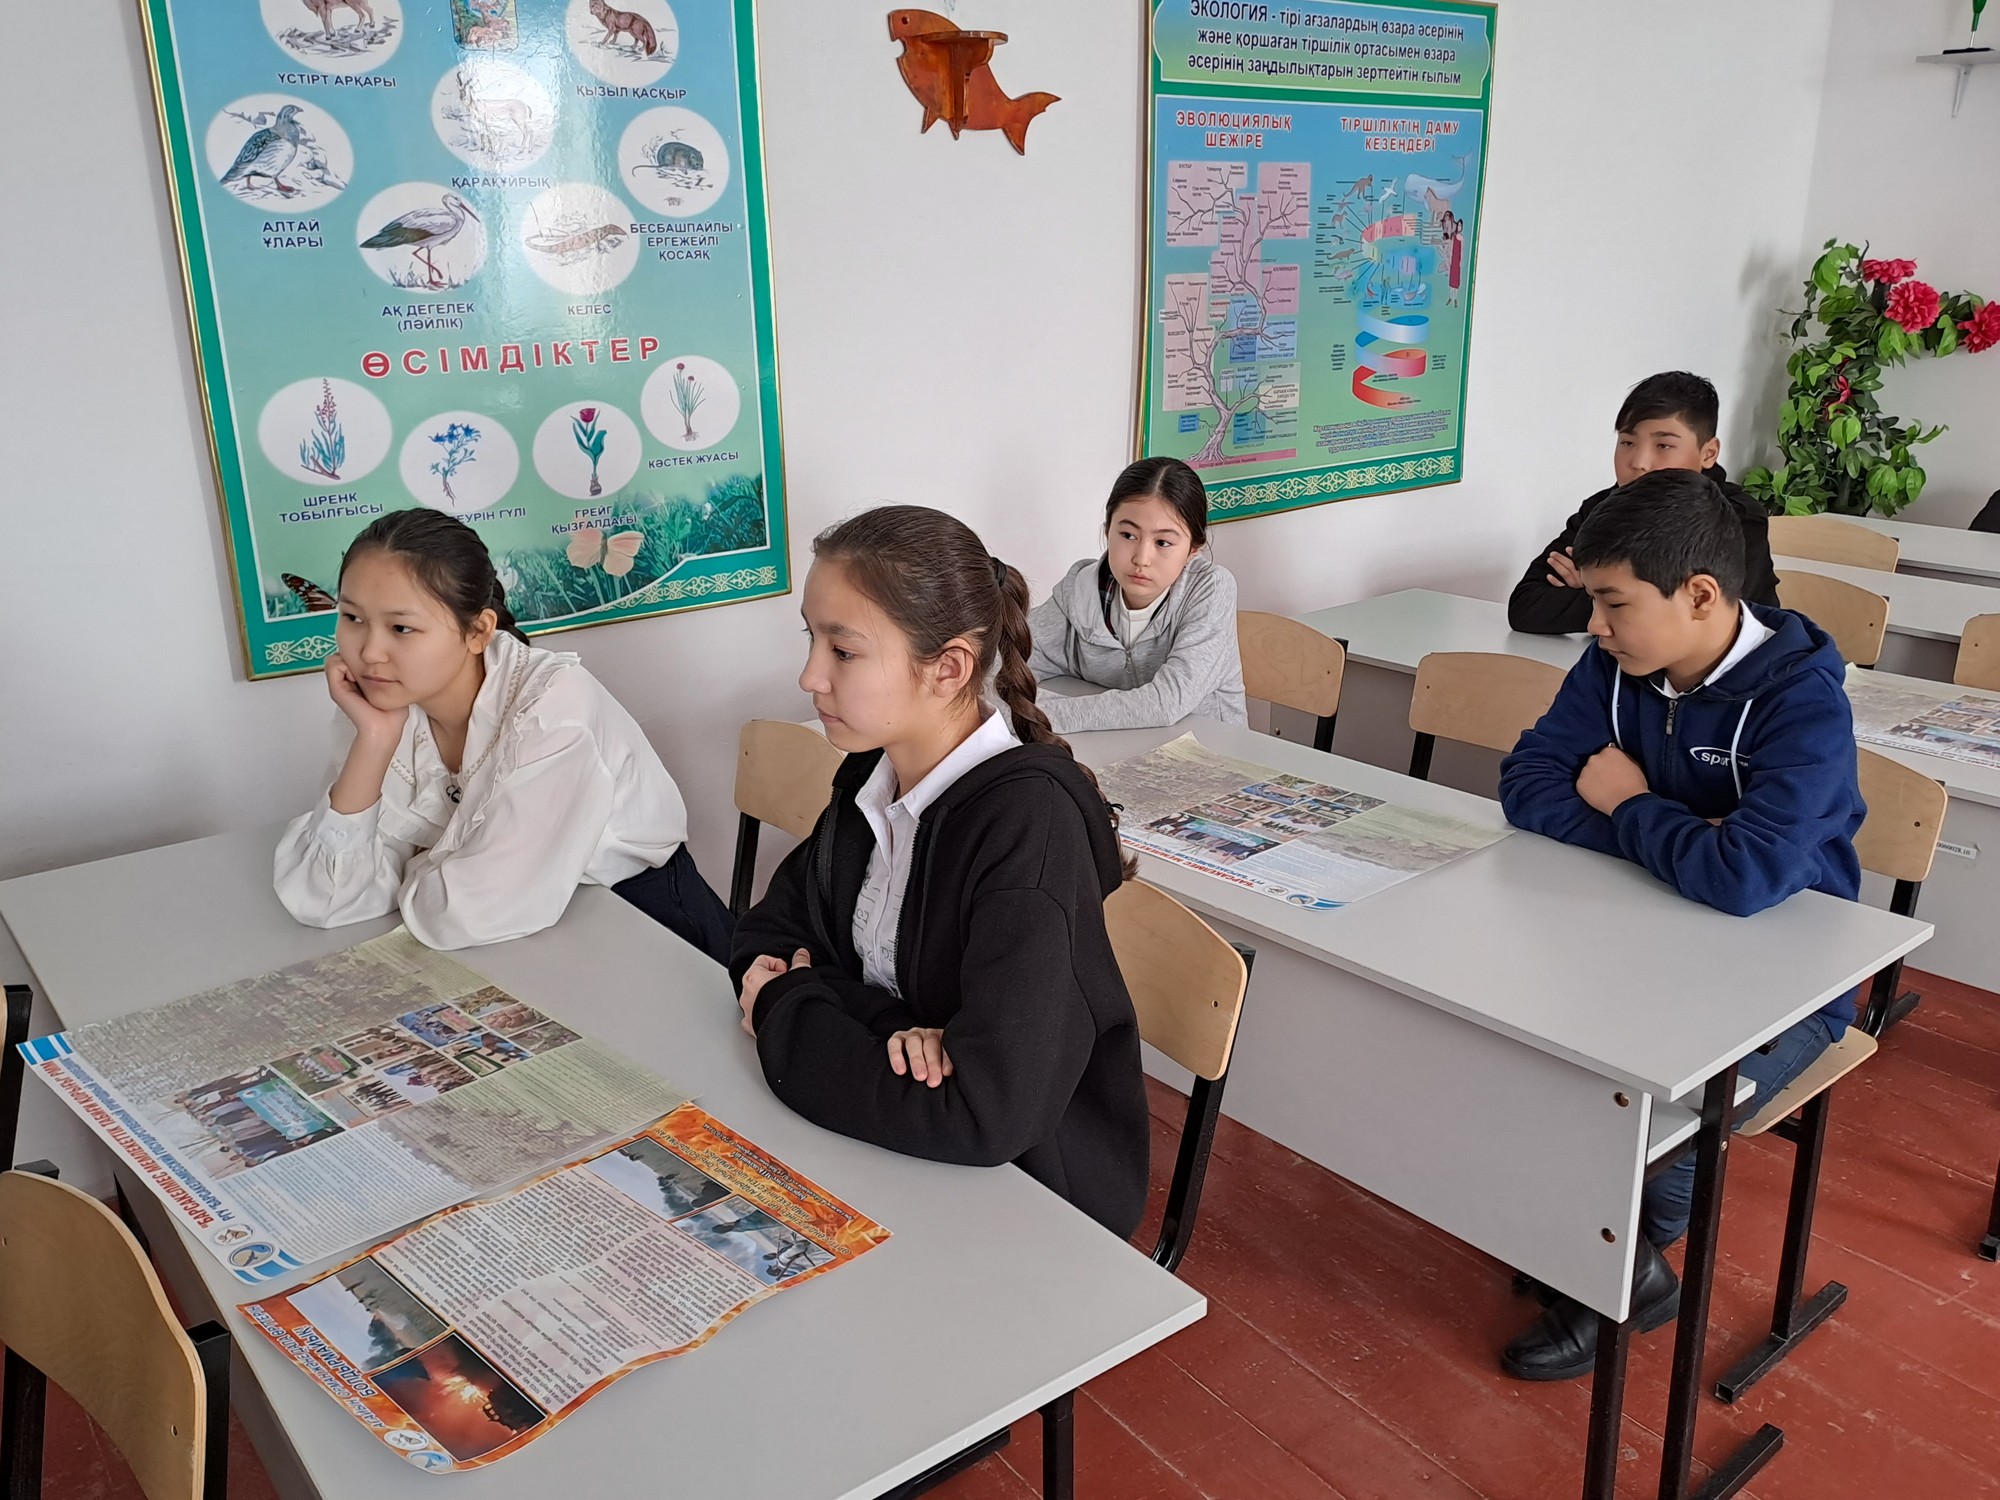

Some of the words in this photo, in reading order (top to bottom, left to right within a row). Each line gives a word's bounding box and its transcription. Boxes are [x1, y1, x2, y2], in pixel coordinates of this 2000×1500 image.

[1191, 0, 1267, 22] ЭКОЛОГИЯ
[1280, 8, 1301, 29] тірі
[1304, 13, 1378, 35] ағзалардың
[1382, 21, 1415, 38] өзара
[1418, 23, 1464, 41] әсерінің
[1198, 29, 1232, 45] және
[1236, 33, 1297, 50] қоршаған
[1302, 35, 1351, 56] тіршілік
[1354, 42, 1420, 59] ортасымен
[1424, 50, 1456, 64] өзара
[1188, 53, 1244, 73] әсерінің
[1248, 58, 1353, 81] заңдылықтарын
[1357, 66, 1418, 82] зерттейтін
[1422, 71, 1461, 84] ғылым
[277, 72, 330, 87] ҮСТІРТ
[334, 75, 397, 91] АРҚАРЫ
[576, 84, 629, 99] ҚЫЗЫЛ
[632, 86, 687, 101] ҚАСҚЫР
[1176, 111, 1292, 131] ЭВОЛЮЦИЯЛЫҚ
[1341, 118, 1421, 135] ТІРШІЛІКТІҢ
[1425, 121, 1459, 135] ДАМУ
[1206, 133, 1263, 149] ШЕЖІРЕ
[1365, 137, 1435, 153] КЕЗЕҢДЕРІ
[450, 175, 551, 191] ҚАРАҚҰЙРЫҚ
[262, 217, 321, 234] АЛТАЙ
[629, 221, 734, 236] БЕСБАШПАЙЛЫ
[262, 235, 324, 250] ҰЛАРЫ
[647, 234, 720, 248] ЕРГЕЖЕЙЛІ
[658, 247, 711, 262] ҚОСАЯҚ
[406, 302, 476, 318] ДЕГЕЛЕК
[567, 302, 612, 317] КЕЛЕС
[396, 316, 464, 334] (ЛӘЙЛІК)
[361, 337, 662, 378] ӨСІМДІКТЕР
[648, 456, 693, 469] КӘСТЕК
[696, 452, 739, 463] ЖУАСЫ
[303, 493, 358, 507] ШРЕНК
[279, 504, 384, 523] ТОБЫЛҒЫСЫ
[499, 507, 526, 519] ГҮЛІ
[575, 506, 613, 519] ГРЕЙГ
[551, 515, 637, 534] ҚЫЗҒАЛДАҒЫ
[214, 1206, 235, 1222] РГУ
